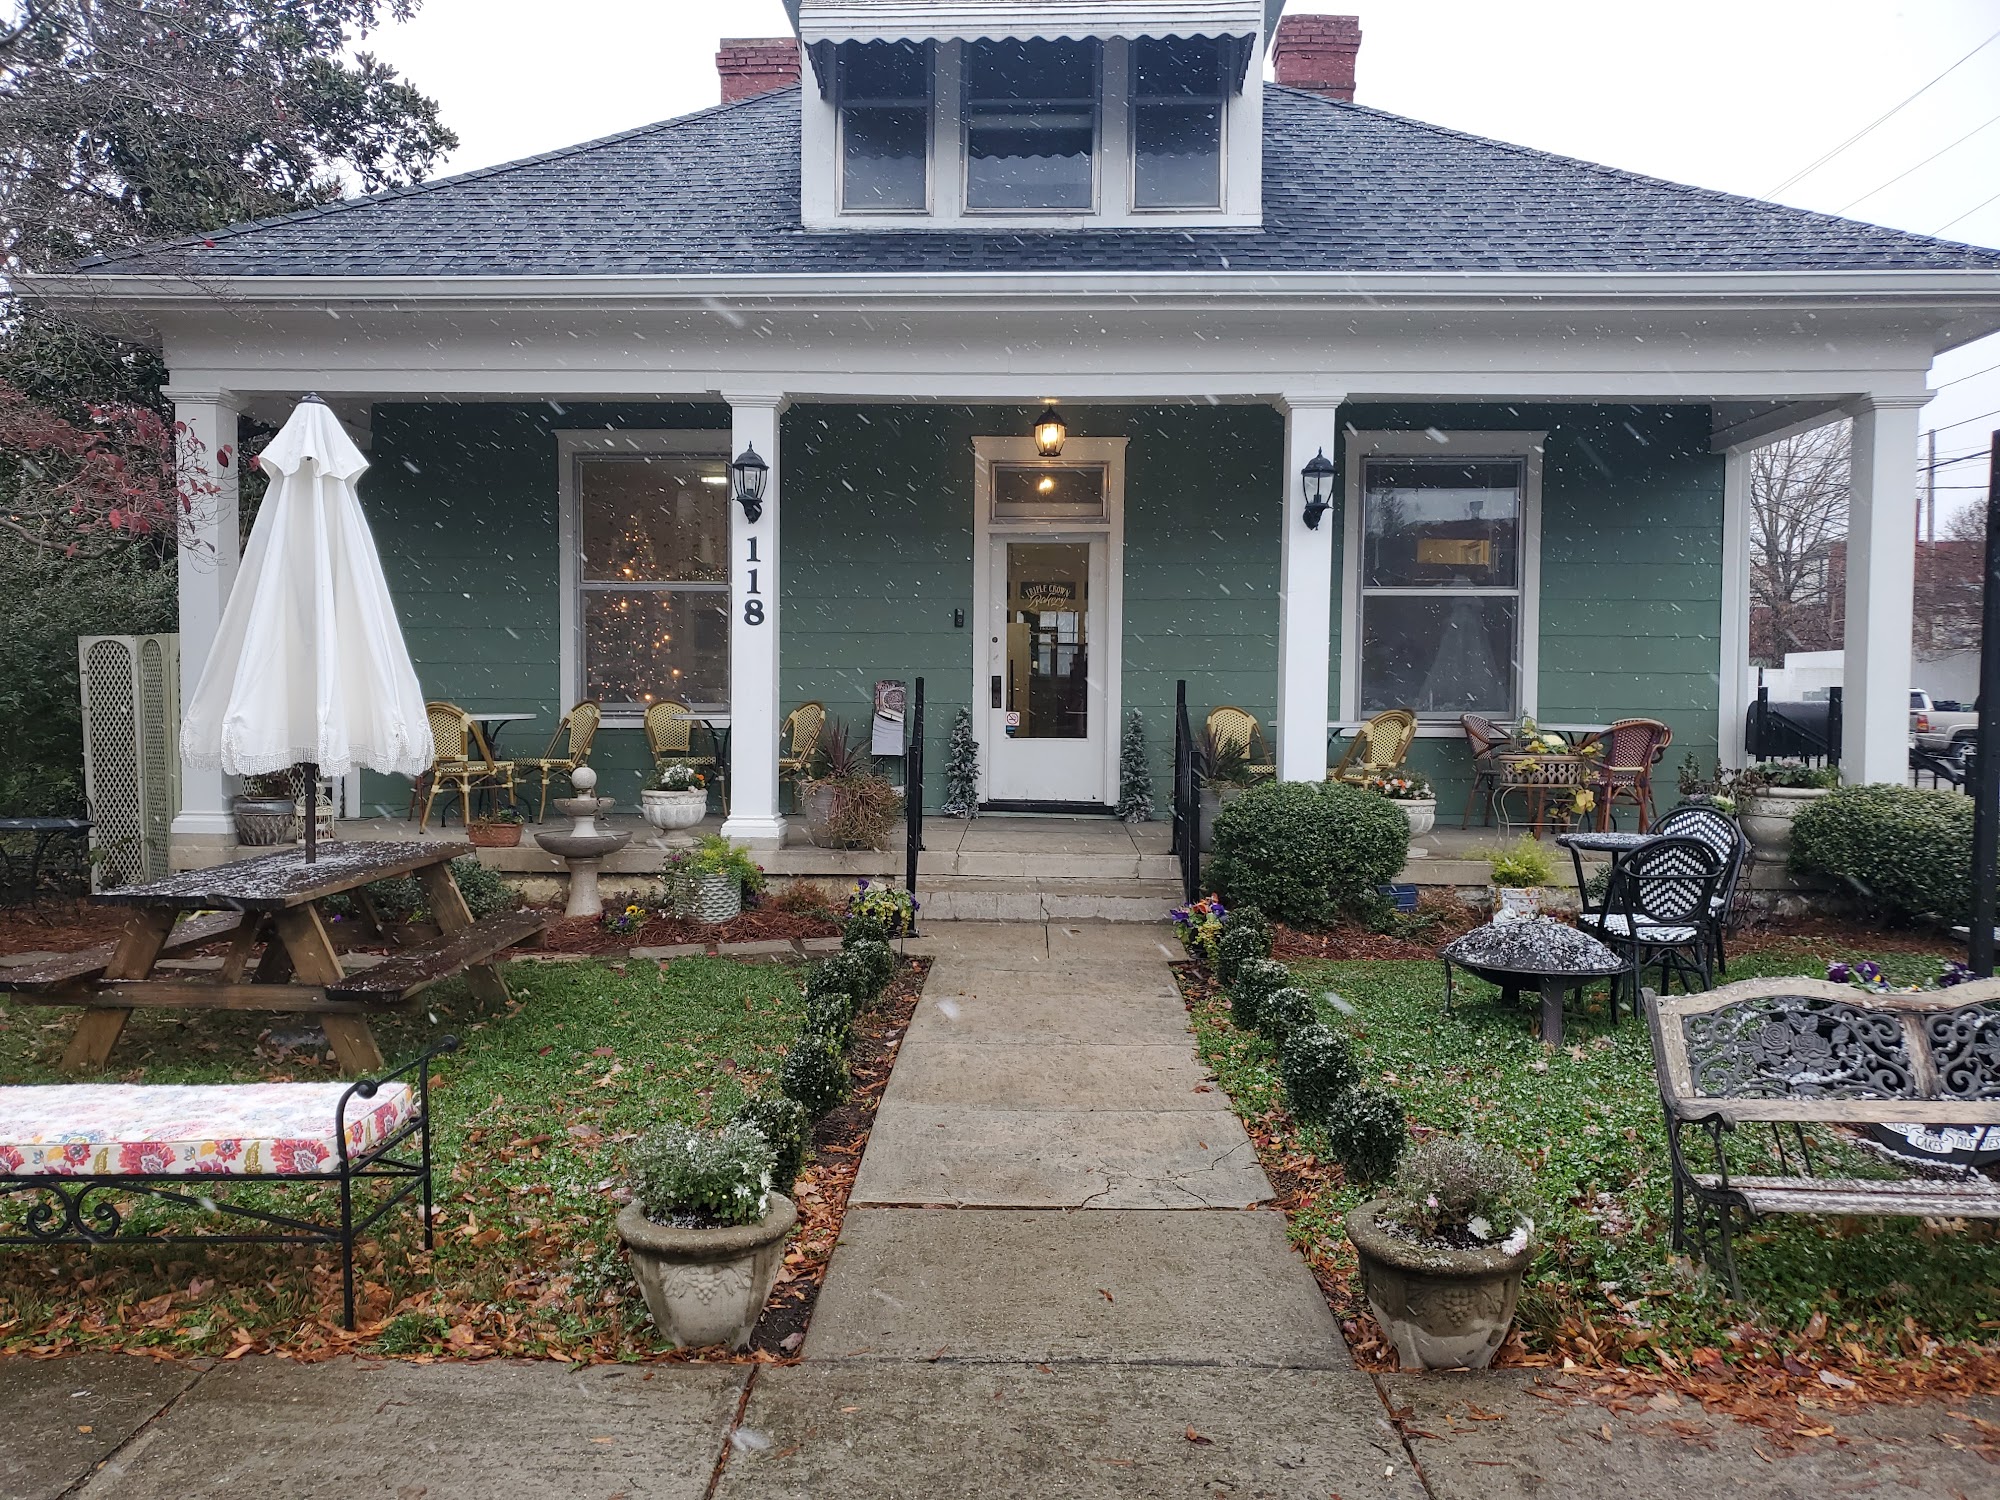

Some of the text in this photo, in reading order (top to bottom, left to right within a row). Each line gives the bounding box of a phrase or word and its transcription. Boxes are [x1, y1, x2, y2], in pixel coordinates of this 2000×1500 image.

[744, 536, 765, 626] 118
[1025, 585, 1071, 597] TRIPLE CROWN
[1028, 592, 1067, 608] Bakery
[1915, 1135, 1944, 1151] CAKES
[1956, 1136, 2000, 1149] PASIES
